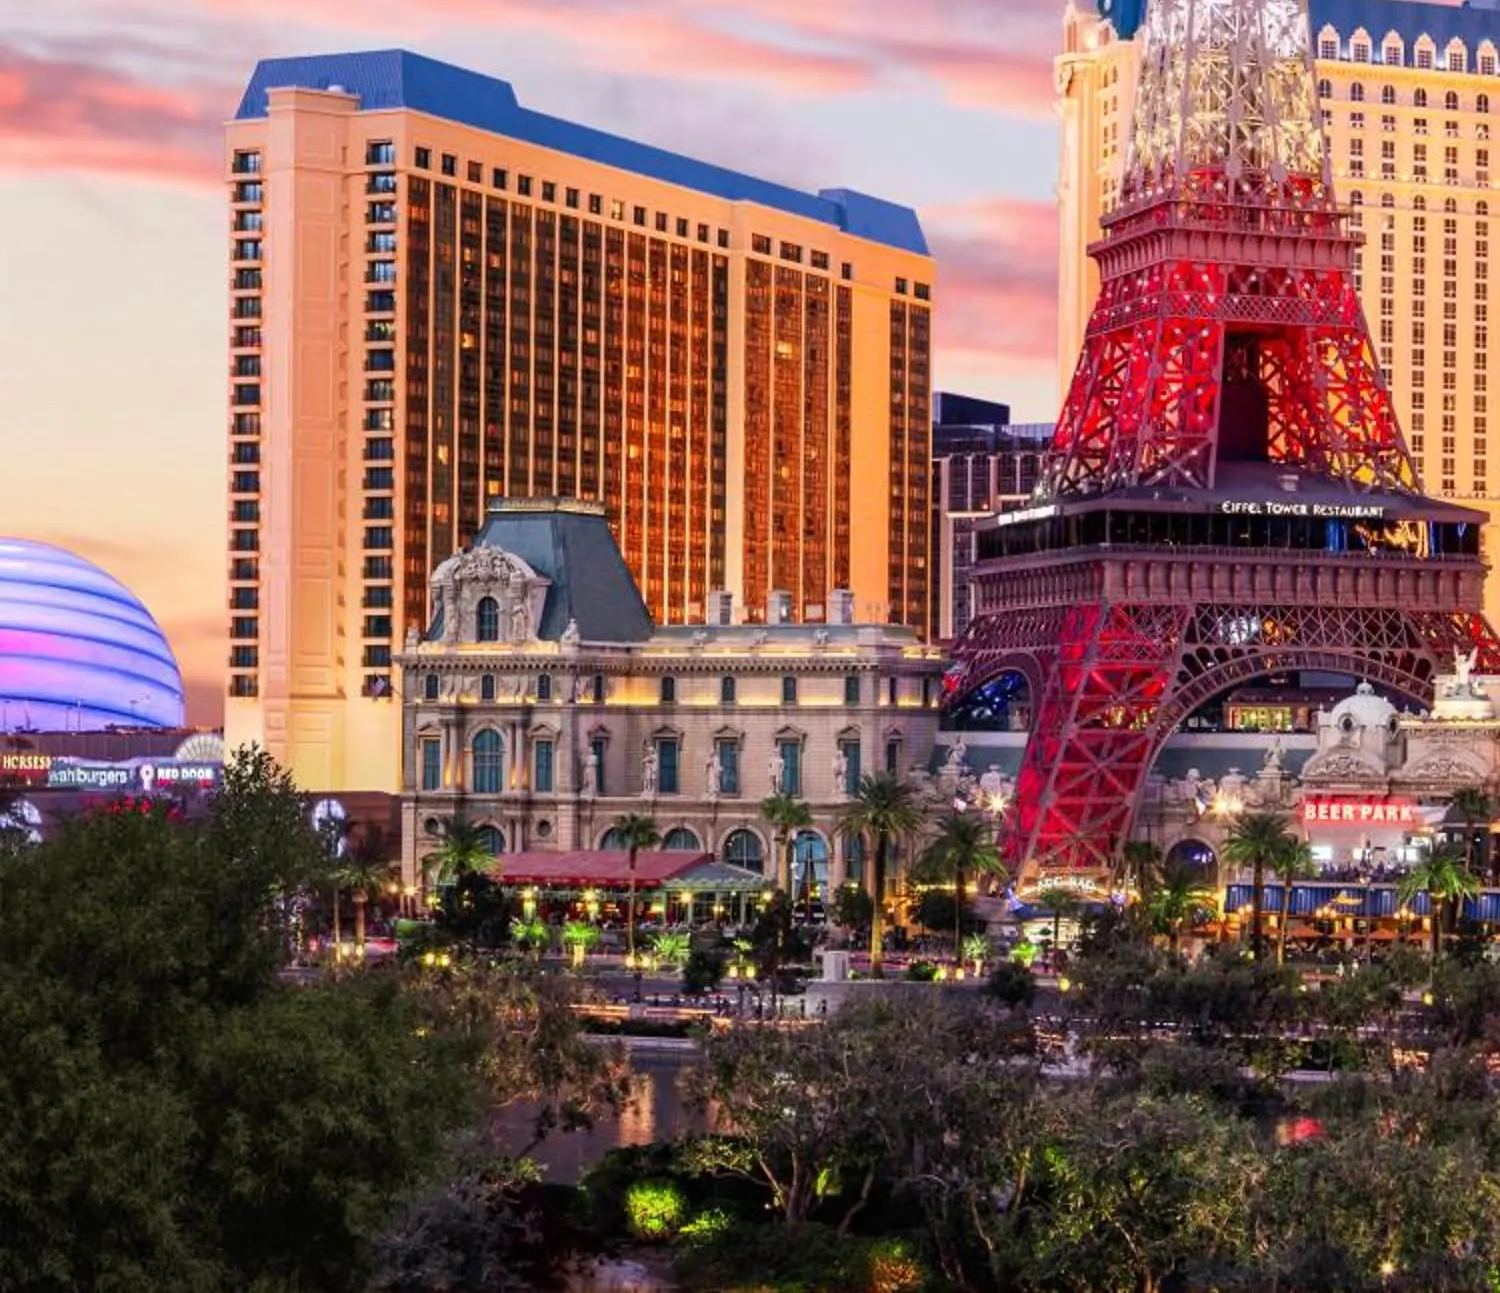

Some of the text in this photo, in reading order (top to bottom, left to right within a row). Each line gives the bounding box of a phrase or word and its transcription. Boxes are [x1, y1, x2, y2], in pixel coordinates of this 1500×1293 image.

[157, 768, 179, 780] RED
[1305, 804, 1412, 821] BEER PARK
